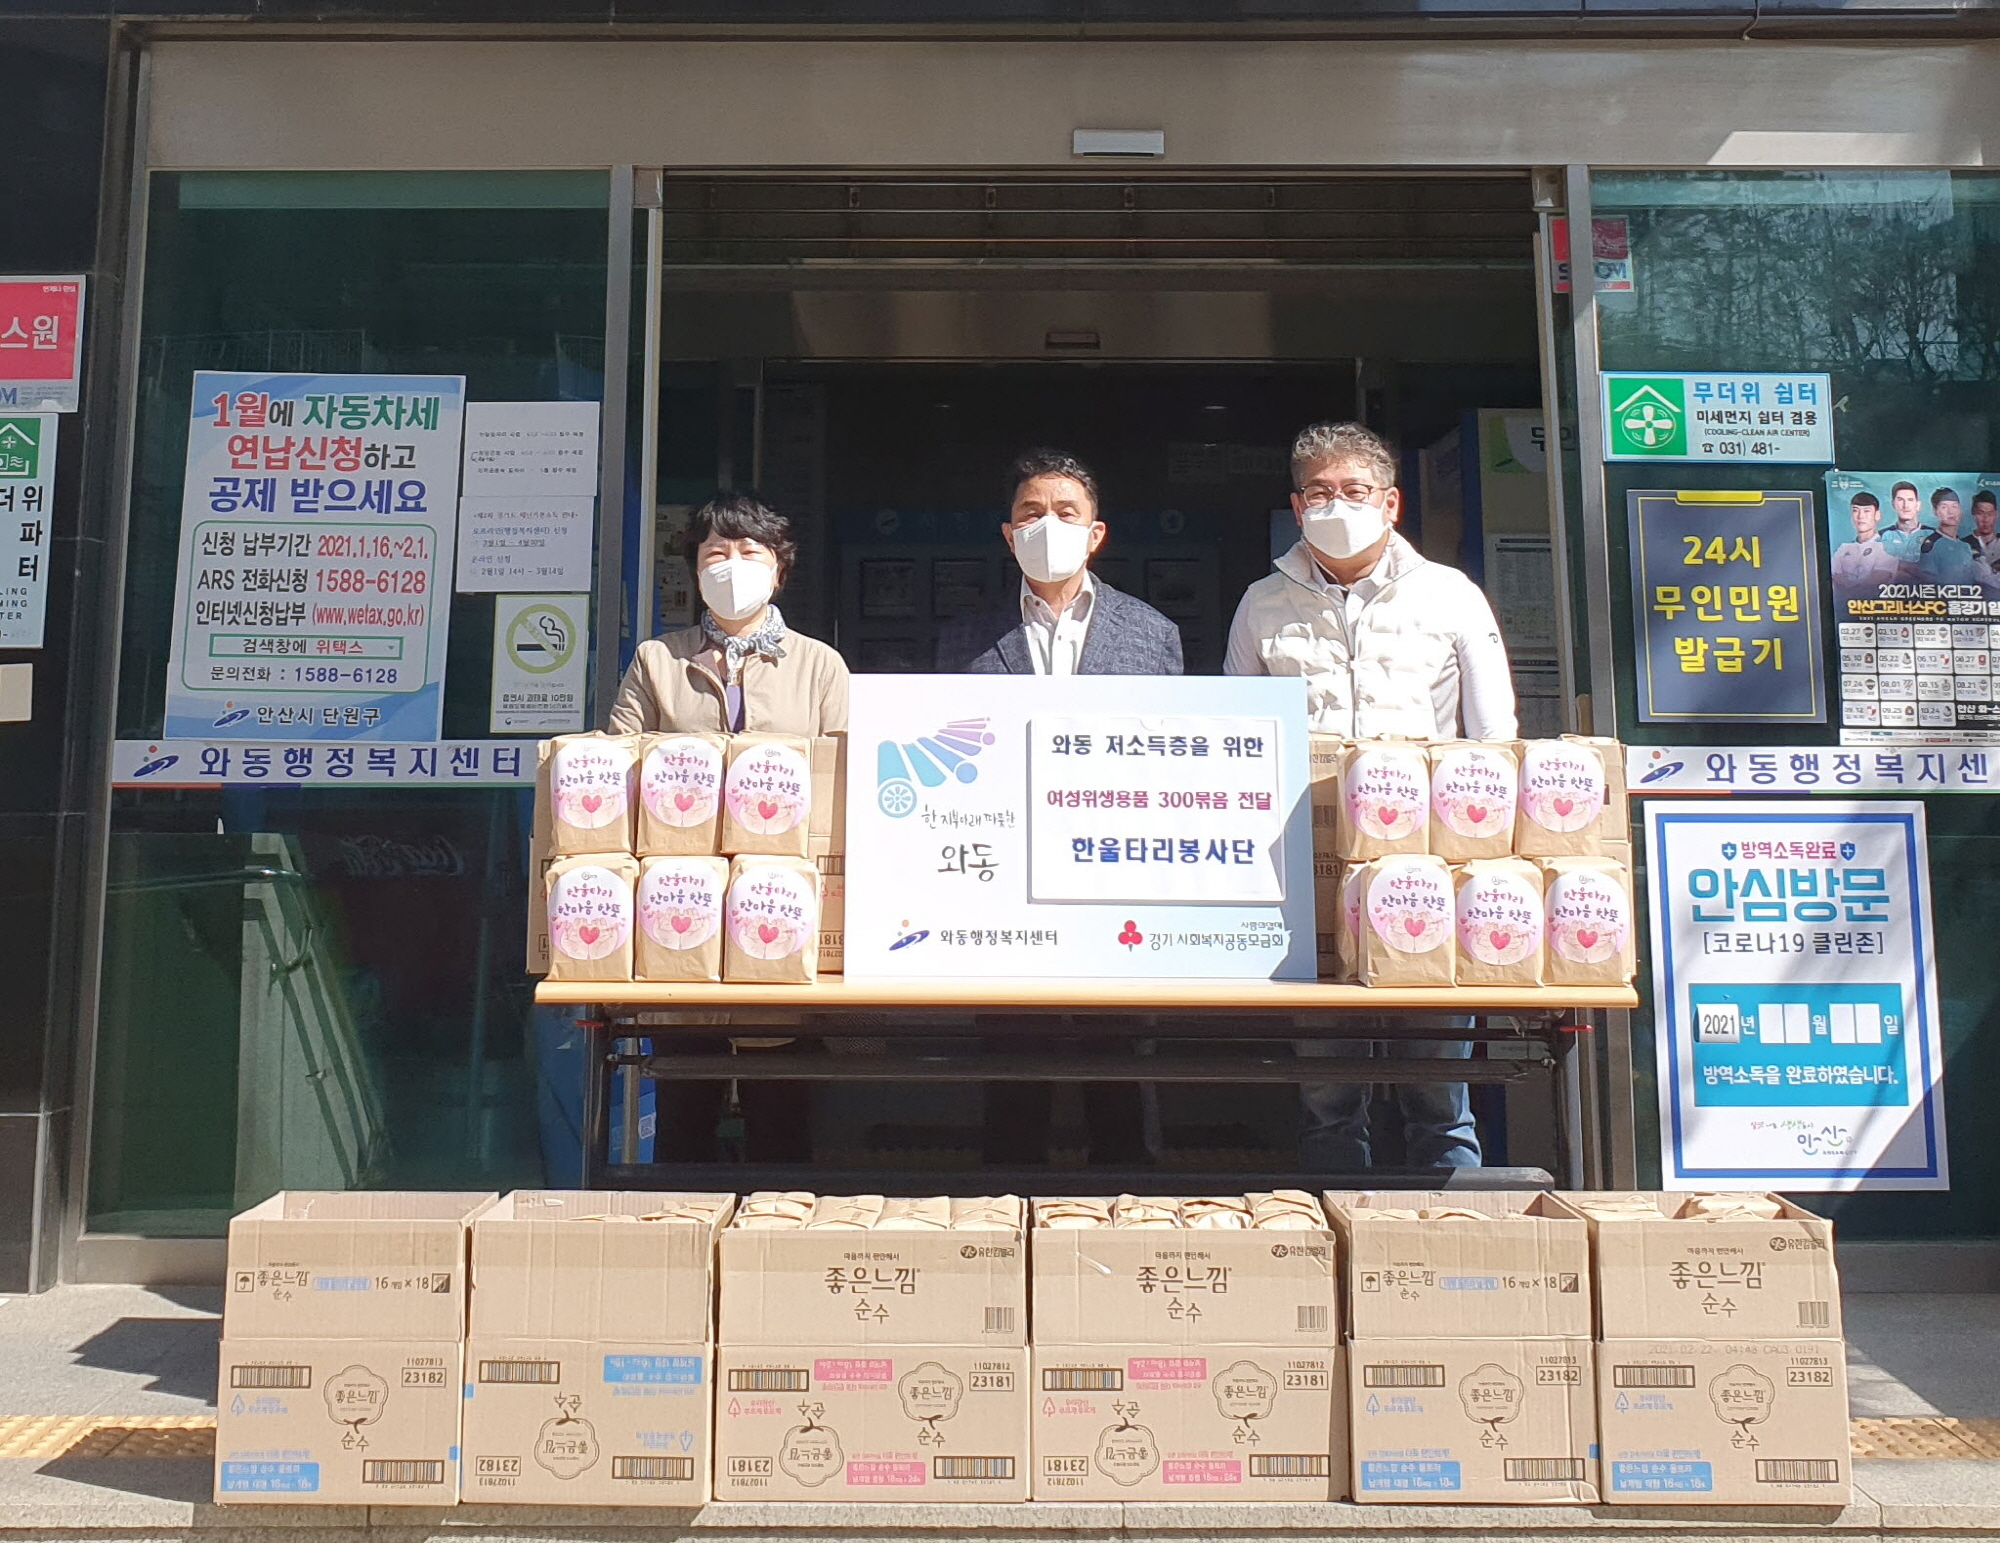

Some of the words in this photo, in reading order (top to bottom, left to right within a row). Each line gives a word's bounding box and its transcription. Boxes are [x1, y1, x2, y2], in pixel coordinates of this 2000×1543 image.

[1692, 381, 1760, 405] 무더위
[1774, 381, 1817, 406] 쉼터
[212, 392, 294, 429] 1월에
[302, 394, 440, 431] 자동차세
[1696, 409, 1752, 425] 미세먼지
[1757, 409, 1784, 425] 쉼터
[1790, 410, 1817, 426] 겸용
[227, 434, 417, 472] 연납신청하고
[1719, 440, 1747, 456] 031)
[1751, 441, 1781, 456] 481-
[209, 476, 277, 514] 공제
[290, 478, 428, 515] 받으세요
[20, 520, 43, 546] 파
[201, 532, 236, 557] 신청
[242, 532, 313, 558] 납부기간
[1681, 535, 1763, 569] 24시
[18, 554, 39, 582] 터
[197, 568, 236, 591] ARS
[240, 568, 308, 594] 전화신청
[315, 568, 427, 594] 1588-6128
[1878, 583, 1937, 600] 2021시즌
[195, 600, 307, 627] 인터넷신청납부
[1653, 584, 1800, 623] 무인민원
[242, 637, 308, 655] 검색창에
[315, 639, 364, 655] 위택스
[1673, 636, 1783, 674] 발급기
[209, 665, 272, 682] 문의전화
[294, 666, 398, 684] 1588-6128
[256, 706, 314, 725] 안산시
[322, 707, 381, 726] 단원구
[1052, 733, 1092, 757] 와동
[1106, 733, 1210, 758] 저소득층을
[1222, 734, 1265, 759] 위한
[199, 746, 521, 778] 와동행정복지센터
[1705, 752, 1989, 785] 와동행정복지센
[1047, 789, 1149, 810] 여성위생용품
[1158, 791, 1229, 810] 300묶음
[1237, 790, 1273, 812] 전달
[1070, 836, 1256, 866] 한울타리봉사단
[1740, 841, 1839, 860] 방역소독완료
[937, 843, 1001, 882] 와동
[1687, 867, 1891, 923] 안심방문
[940, 929, 1059, 948] 와동행정복지센터
[1703, 931, 1805, 955] [코로나19
[1812, 931, 1884, 956] 클린존]
[1703, 1013, 1736, 1036] 2021
[1740, 1015, 1757, 1036] 년
[1811, 1014, 1829, 1036] 월
[1883, 1014, 1900, 1036] 일
[1702, 1065, 1782, 1086] 방역소독을
[1785, 1065, 1900, 1087] 완료하였습니다.
[257, 1270, 310, 1288] 좋은느낌
[374, 1276, 389, 1290] 16
[415, 1276, 430, 1290] 18
[824, 1266, 917, 1295] 좋은느낌
[1136, 1265, 1230, 1294] 좋은느낌
[1382, 1269, 1435, 1287] 좋은느낌
[1502, 1276, 1517, 1289] 16
[1543, 1276, 1558, 1289] 18
[1668, 1260, 1763, 1290] 좋은느낌
[1399, 1287, 1421, 1302] 순수
[1700, 1292, 1739, 1319] 순수
[853, 1297, 891, 1325] 순수
[1166, 1296, 1203, 1324] 순수
[403, 1371, 444, 1384] 23182
[971, 1375, 1012, 1389] 23181
[1285, 1373, 1326, 1387] 23181
[1538, 1369, 1579, 1382] 23182
[1788, 1370, 1830, 1384] 23182
[1470, 1388, 1515, 1403] 좋은느낌
[1719, 1387, 1766, 1404] 좋은느낌
[340, 1431, 370, 1453] 순수
[917, 1426, 947, 1449] 순수
[1231, 1425, 1261, 1448] 순수
[1478, 1429, 1509, 1451] 순수
[1729, 1429, 1761, 1452] 순수
